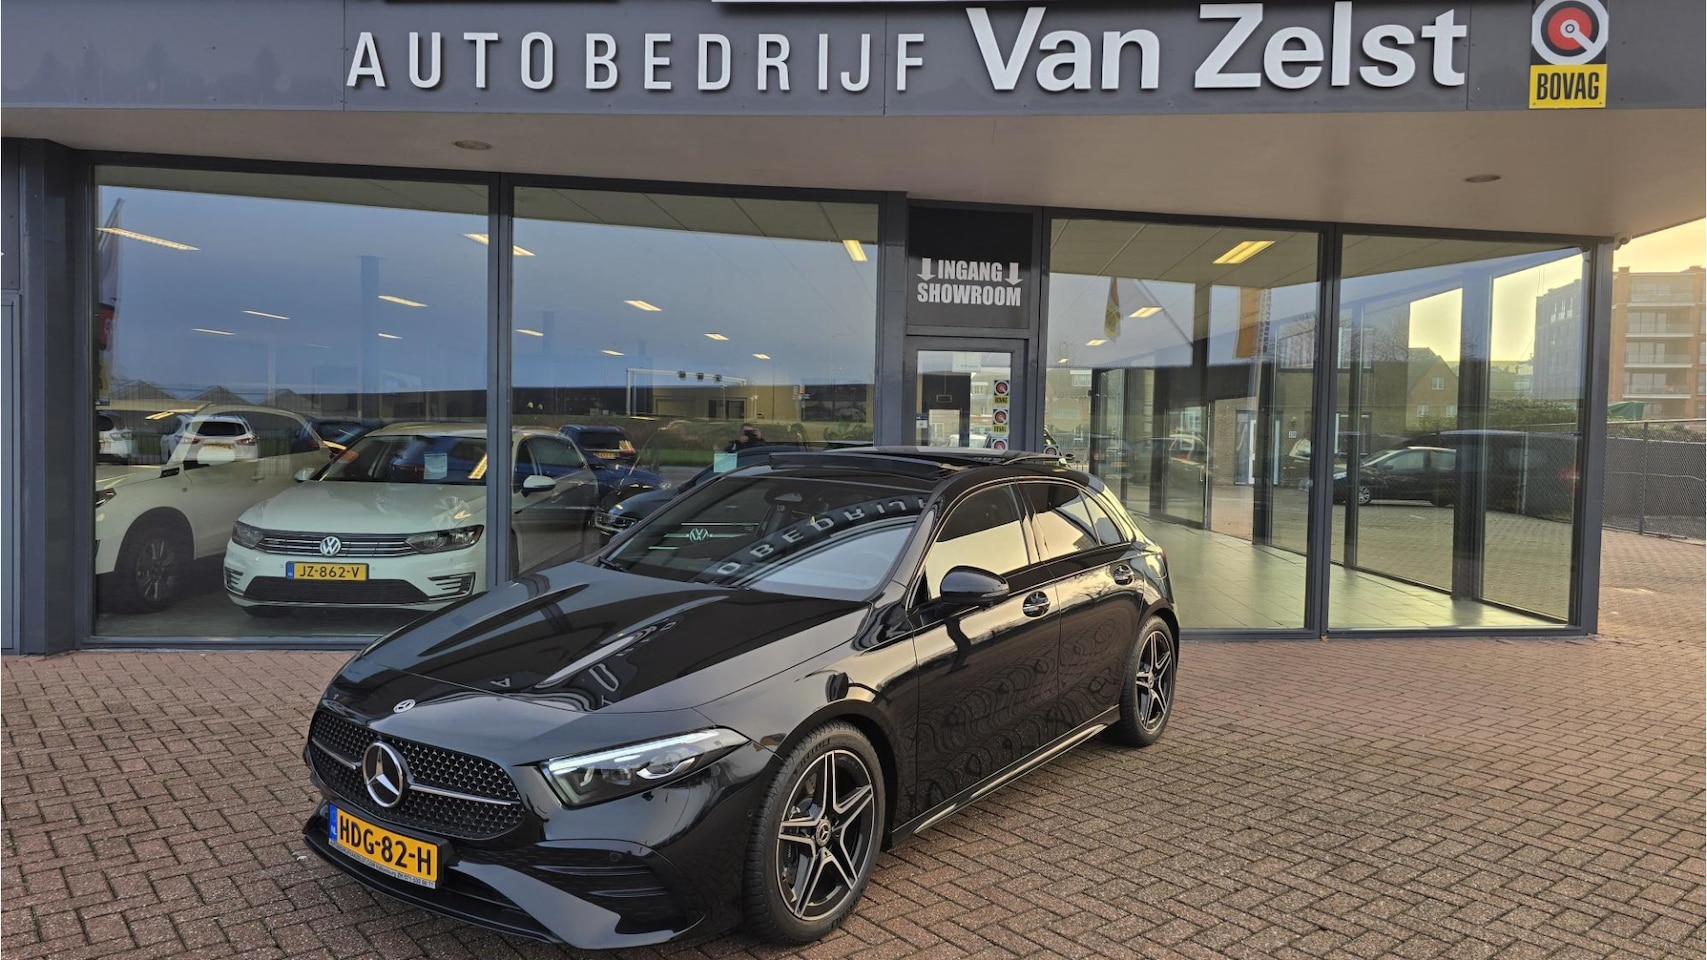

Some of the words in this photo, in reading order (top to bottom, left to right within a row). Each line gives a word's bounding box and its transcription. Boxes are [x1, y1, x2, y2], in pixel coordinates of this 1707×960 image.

[346, 31, 925, 93] AUTOBEDRIJF
[966, 6, 1160, 91] Van
[1194, 1, 1467, 90] Zelst
[1537, 71, 1600, 100] BOVAG
[938, 259, 1003, 282] INGANG
[917, 282, 1021, 306] SHOWROOM
[299, 565, 360, 578] JZ-862-V
[340, 815, 431, 876] HDG-82-H
